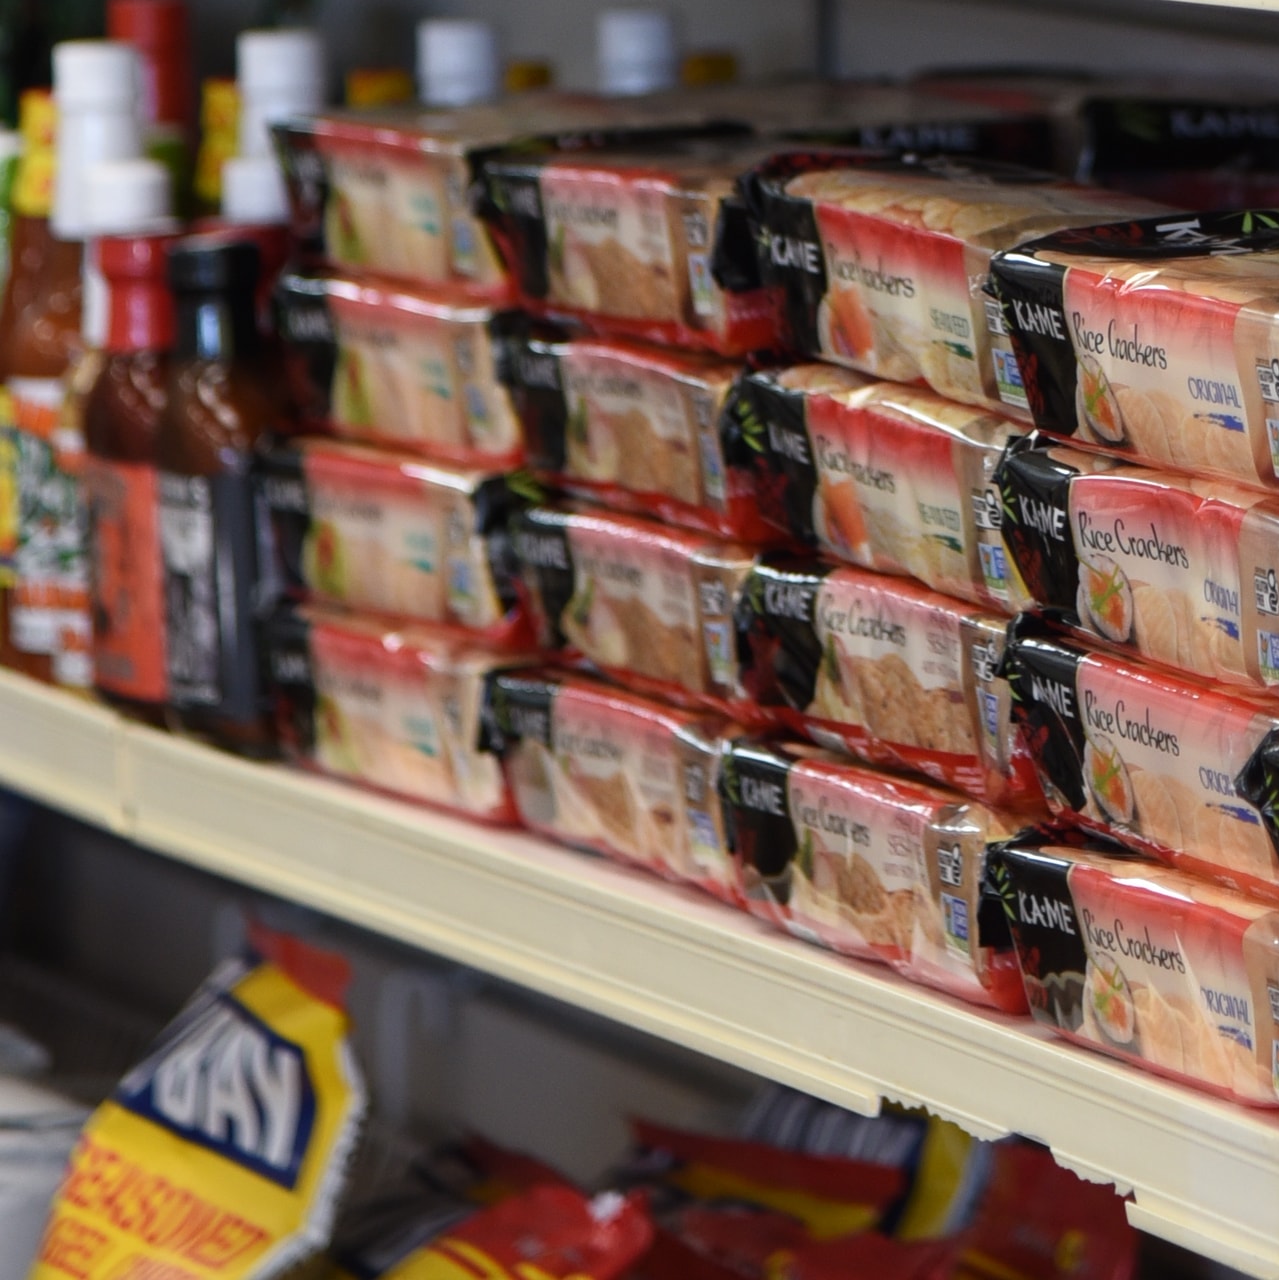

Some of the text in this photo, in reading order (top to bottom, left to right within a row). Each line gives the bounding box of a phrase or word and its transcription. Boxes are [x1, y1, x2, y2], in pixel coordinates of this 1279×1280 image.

[1072, 311, 1168, 369] Rice Crackers
[1187, 377, 1242, 409] ORIGINAL
[1078, 511, 1190, 570] Rice Crackers
[1085, 690, 1180, 757] Rice Crackers
[1082, 908, 1187, 975] Rice Crackers
